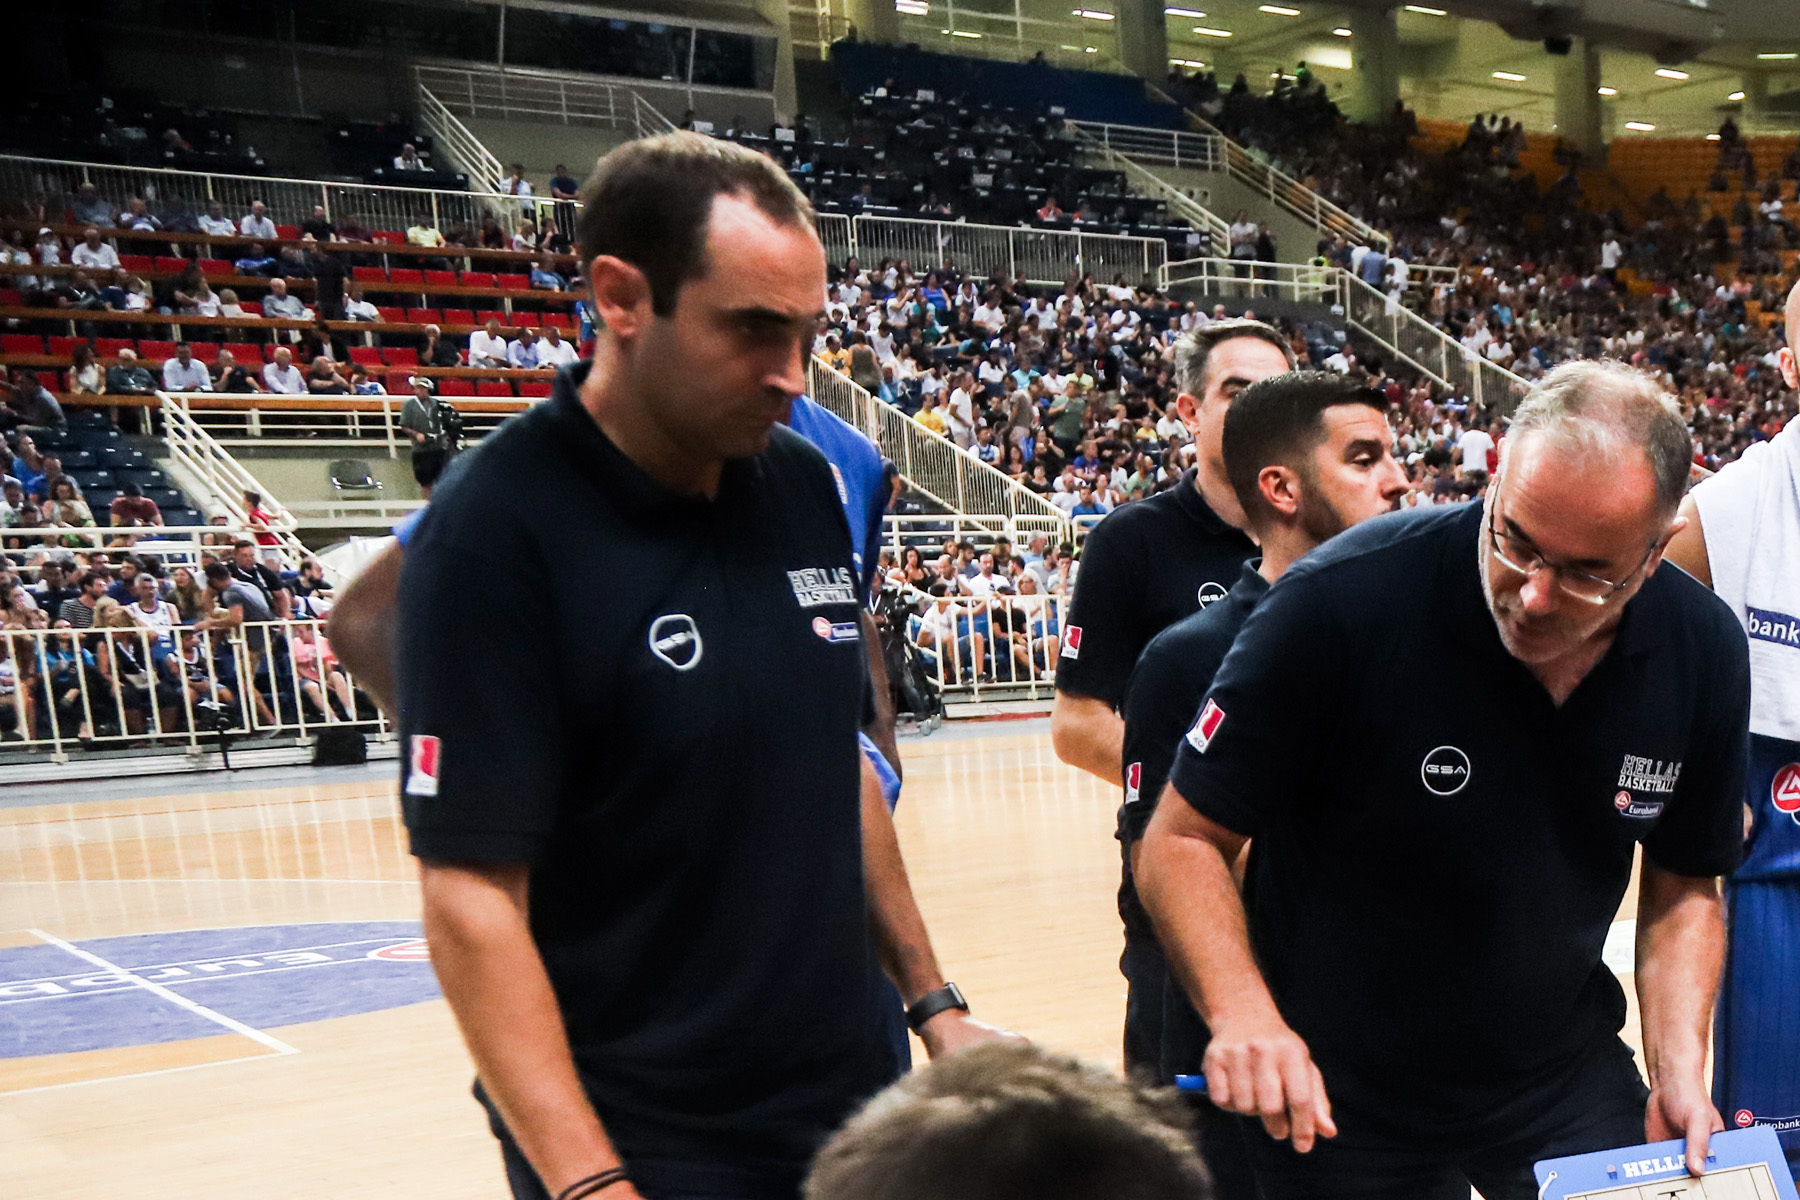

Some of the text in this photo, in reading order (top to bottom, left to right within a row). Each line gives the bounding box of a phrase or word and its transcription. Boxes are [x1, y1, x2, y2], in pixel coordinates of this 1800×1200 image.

[1426, 764, 1466, 775] GSA
[1620, 754, 1682, 780] HELLAS
[1617, 775, 1674, 792] BASKETBALL
[1622, 1154, 1686, 1178] HELL
